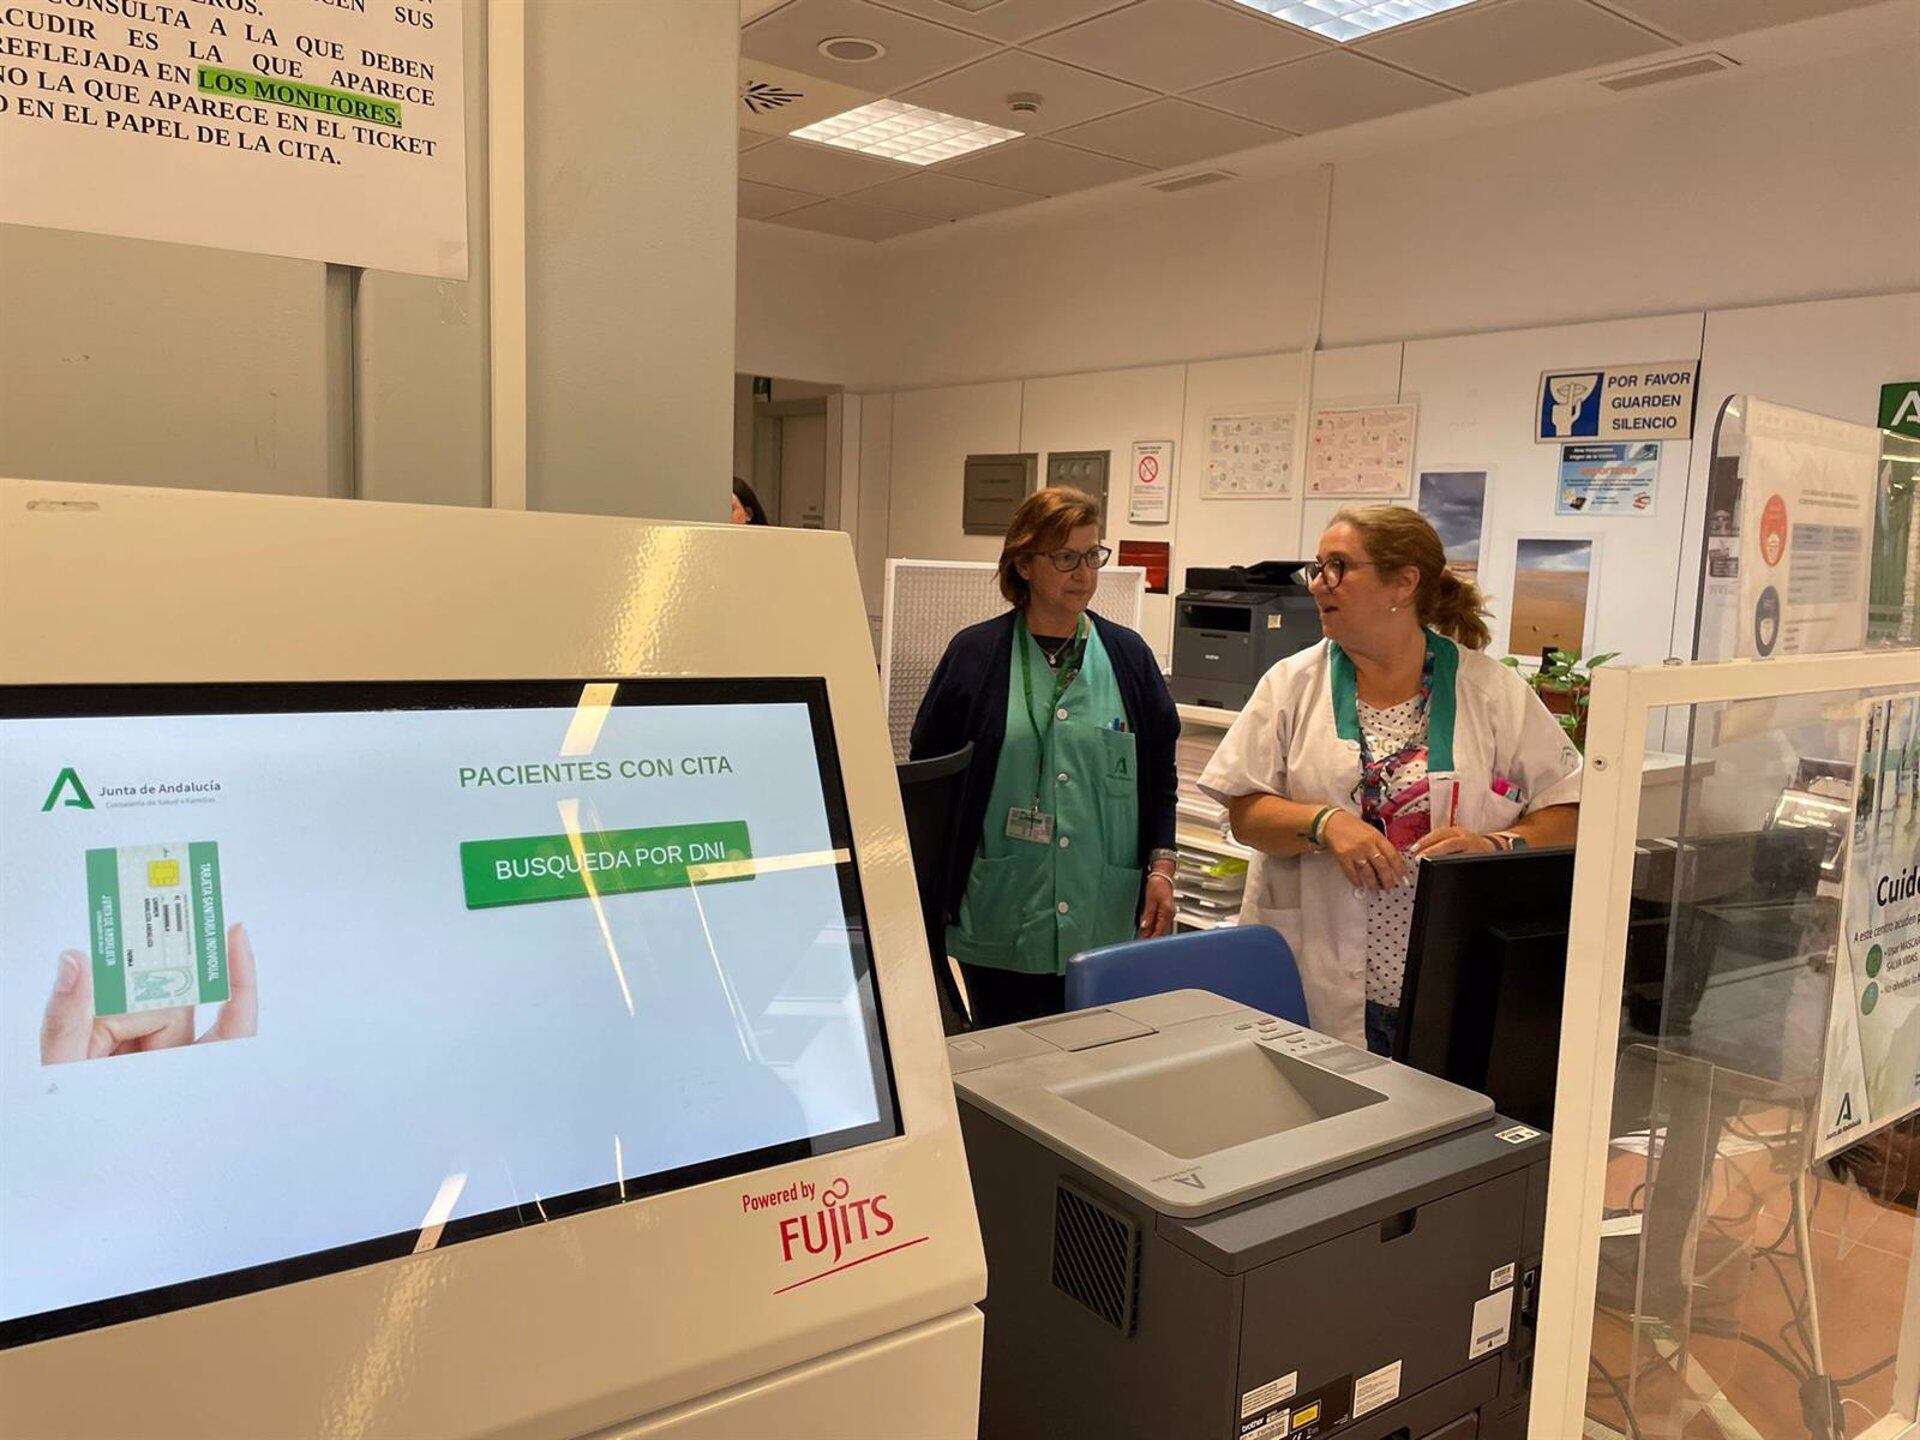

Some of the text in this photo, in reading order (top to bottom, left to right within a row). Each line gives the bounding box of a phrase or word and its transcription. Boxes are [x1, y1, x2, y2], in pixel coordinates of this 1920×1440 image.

[395, 6, 434, 30] SUS
[0, 7, 435, 107] CUDIR ES LA QUE APARECE
[209, 17, 227, 37] A
[244, 23, 278, 47] LA
[296, 35, 345, 61] QUE
[361, 49, 434, 81] DEBEN
[157, 62, 191, 85] EN
[198, 70, 247, 95] LOS
[254, 81, 402, 126] MONITORES.
[38, 71, 75, 94] LA
[84, 79, 140, 104] QUE
[149, 90, 268, 126] APARECE
[277, 112, 308, 133] EN
[316, 119, 346, 140] EL
[352, 126, 437, 157] TICKET
[17, 97, 54, 119] EN
[63, 104, 97, 126] EL
[105, 110, 189, 140] PAPEL
[197, 126, 230, 147] DE
[237, 132, 271, 154] LA
[278, 139, 342, 165] CITA.
[1607, 372, 1690, 388] POR FAVOR
[1611, 394, 1681, 409] GUARDEN
[1612, 416, 1677, 430] SILENCIO
[459, 755, 733, 788] PACIENTES CON CITA
[99, 780, 221, 797] Junta de Andalucía
[496, 840, 726, 881] BUSQUEDA POR DNI
[742, 1181, 816, 1213] Powered by
